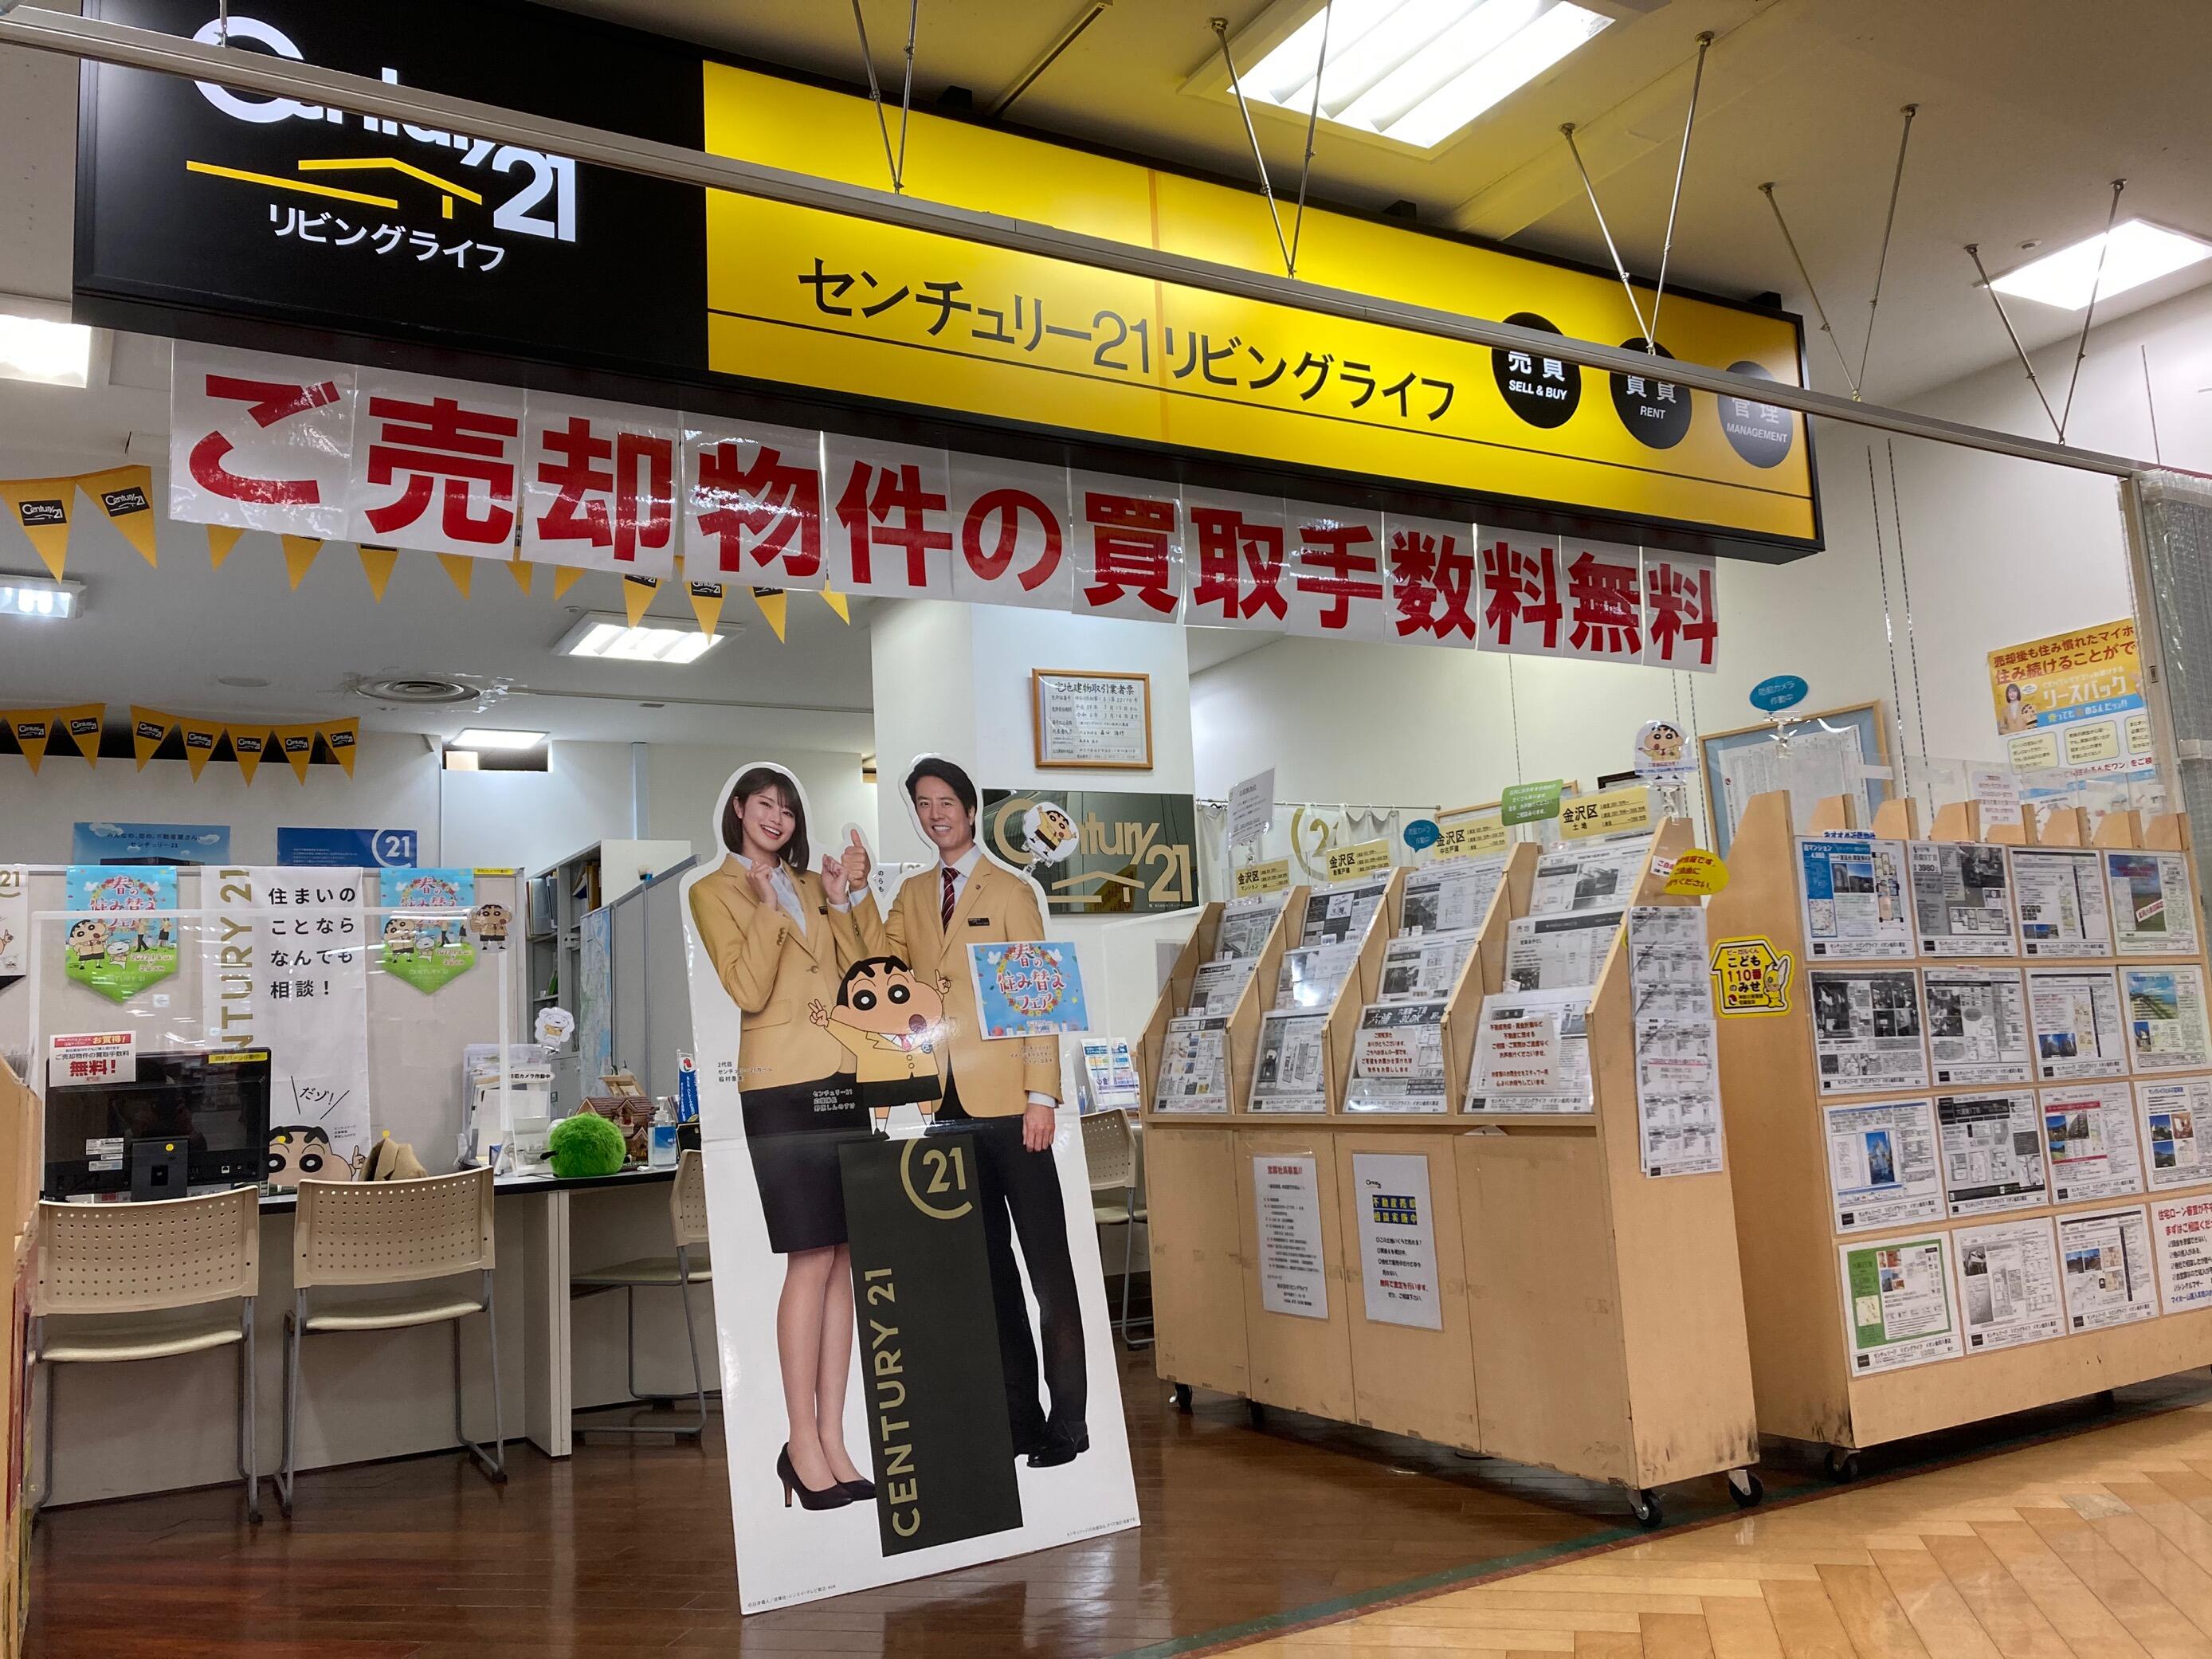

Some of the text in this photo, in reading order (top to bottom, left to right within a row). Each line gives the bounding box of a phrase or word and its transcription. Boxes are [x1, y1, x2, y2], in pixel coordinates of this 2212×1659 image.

[270, 204, 505, 272] リビングライフ
[798, 257, 1455, 422] センチュリー21リビングライフ
[1508, 380, 1567, 401] SELL & BUY
[1640, 406, 1665, 420] RENT
[1727, 423, 1787, 443] MANAGEMENT
[189, 374, 1718, 665] ご売却物件の買取手数料無料
[1055, 682, 1134, 696] 宅地建物取引業者票
[2043, 677, 2126, 709] リースバック
[1563, 804, 1598, 823] 金沢区
[385, 836, 410, 858] 21
[1436, 830, 1465, 847] 金沢区
[1329, 853, 1355, 869] 金沢区
[1144, 844, 1193, 902] 21
[1237, 870, 1260, 885] 金沢区
[269, 887, 355, 906] 住まいの
[272, 917, 355, 935] ことなら
[270, 949, 353, 967] なんでも
[1012, 943, 1042, 967] 春の
[1728, 955, 1761, 968] こども
[270, 980, 330, 999] 相談！
[997, 970, 1067, 994] 住み替え
[1729, 981, 1760, 993] のみせ
[1016, 993, 1053, 1010] フェア
[923, 1147, 967, 1194] 21
[865, 1269, 920, 1537] CENTURY 21
